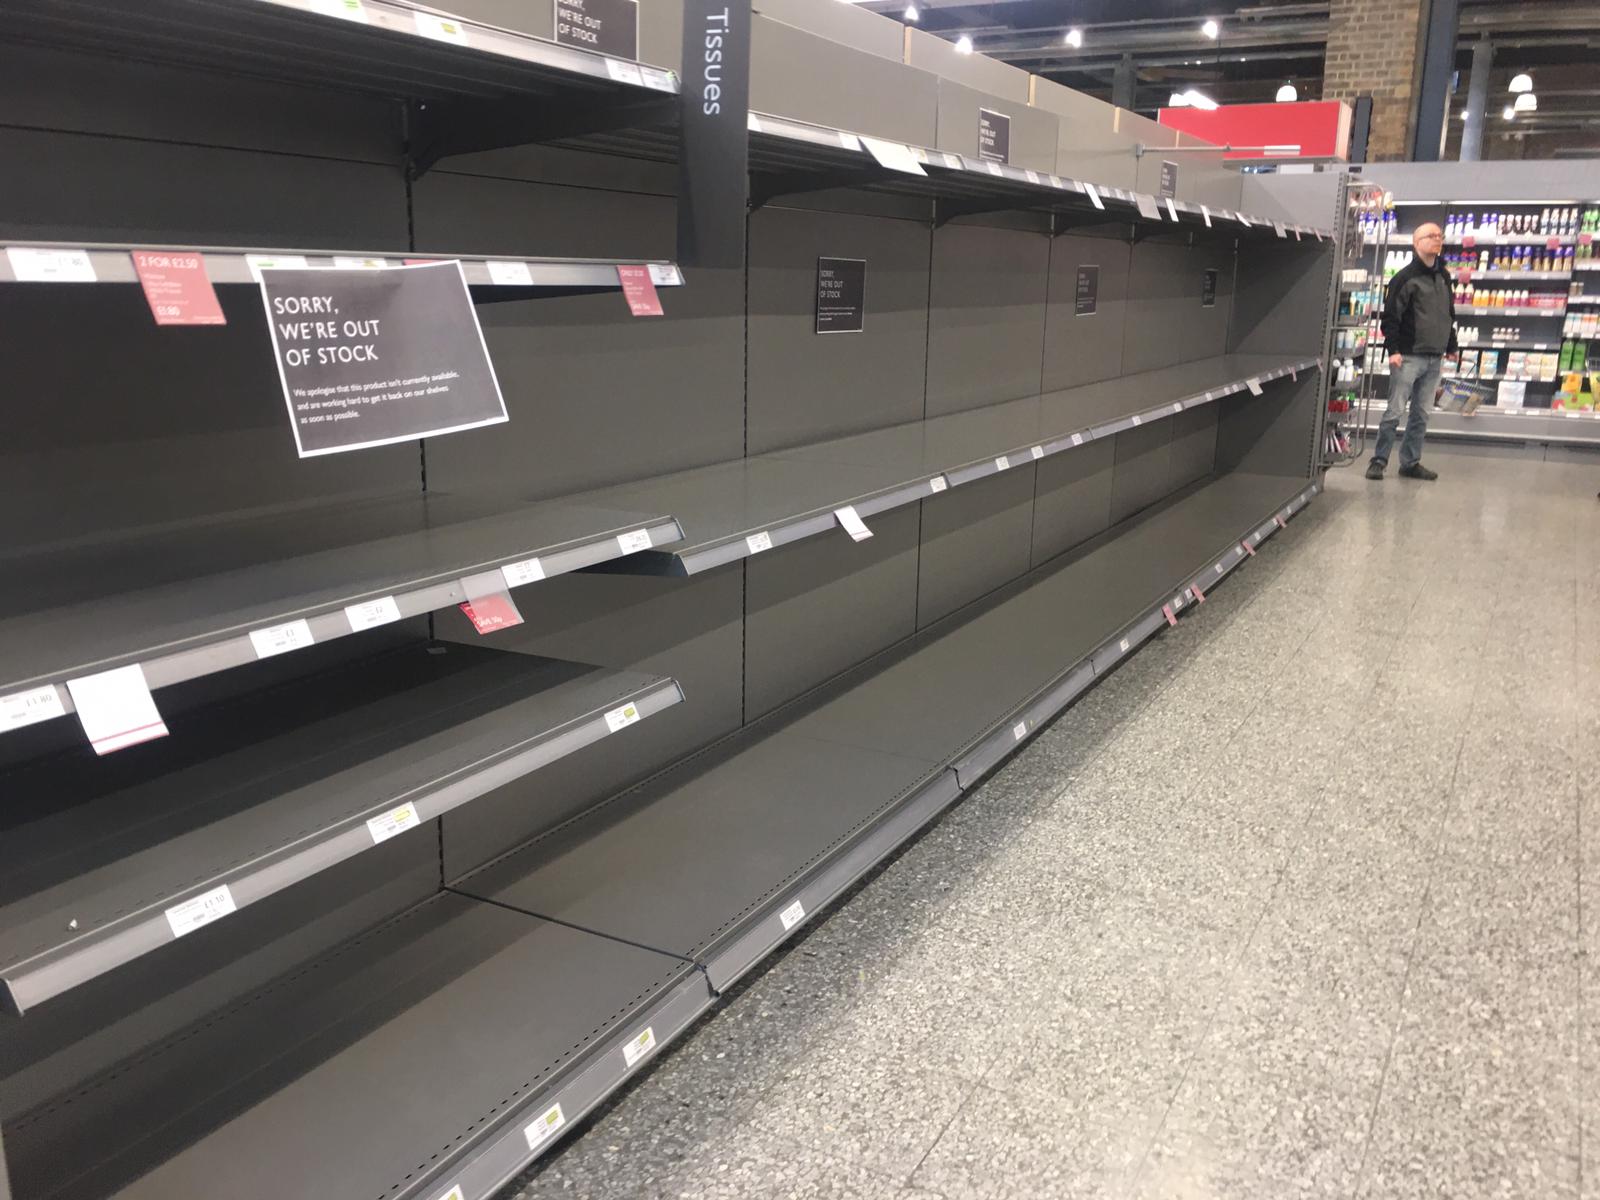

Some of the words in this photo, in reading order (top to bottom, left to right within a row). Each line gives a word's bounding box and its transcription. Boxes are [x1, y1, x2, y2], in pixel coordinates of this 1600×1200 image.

[559, 8, 583, 24] WE'RE
[584, 16, 602, 30] OUT
[559, 23, 570, 34] OF
[572, 27, 598, 43] STOCK
[703, 7, 730, 115] Tissues
[274, 296, 339, 315] SORRY,
[278, 321, 338, 340] WE'RE
[343, 319, 380, 337] OUT
[286, 348, 311, 366] OF
[317, 344, 379, 364] STOCK
[293, 387, 306, 397] We
[336, 384, 350, 393] that
[350, 384, 362, 392] this
[363, 381, 387, 392] product
[402, 374, 430, 384] currently
[297, 402, 309, 411] and
[321, 399, 347, 408] working
[347, 396, 361, 405] hard
[371, 395, 381, 405] get
[381, 393, 387, 401] it
[387, 391, 403, 400] back
[413, 389, 424, 397] our
[309, 415, 325, 423] soon
[333, 410, 360, 422] possible.
